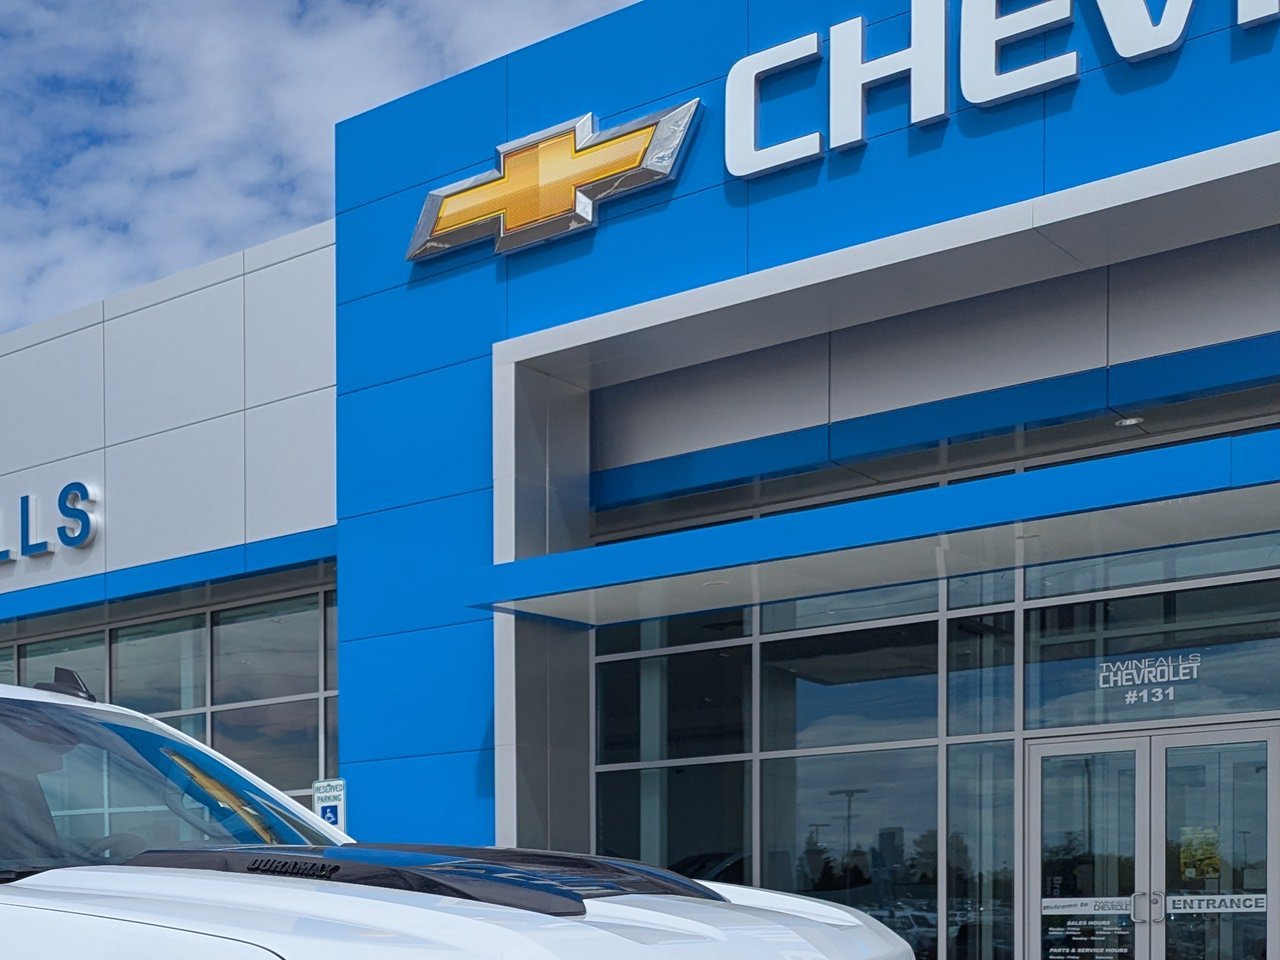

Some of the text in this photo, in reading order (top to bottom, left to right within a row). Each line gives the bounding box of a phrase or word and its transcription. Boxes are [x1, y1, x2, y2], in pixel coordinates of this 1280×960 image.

[725, 0, 1280, 178] CHE
[1099, 663, 1201, 688] CHEVROLET
[1124, 686, 1175, 705] #131
[314, 783, 343, 794] RESERVED
[316, 793, 342, 804] PARKING
[247, 859, 341, 879] DURAMAX
[1172, 898, 1265, 909] ENTRANCE
